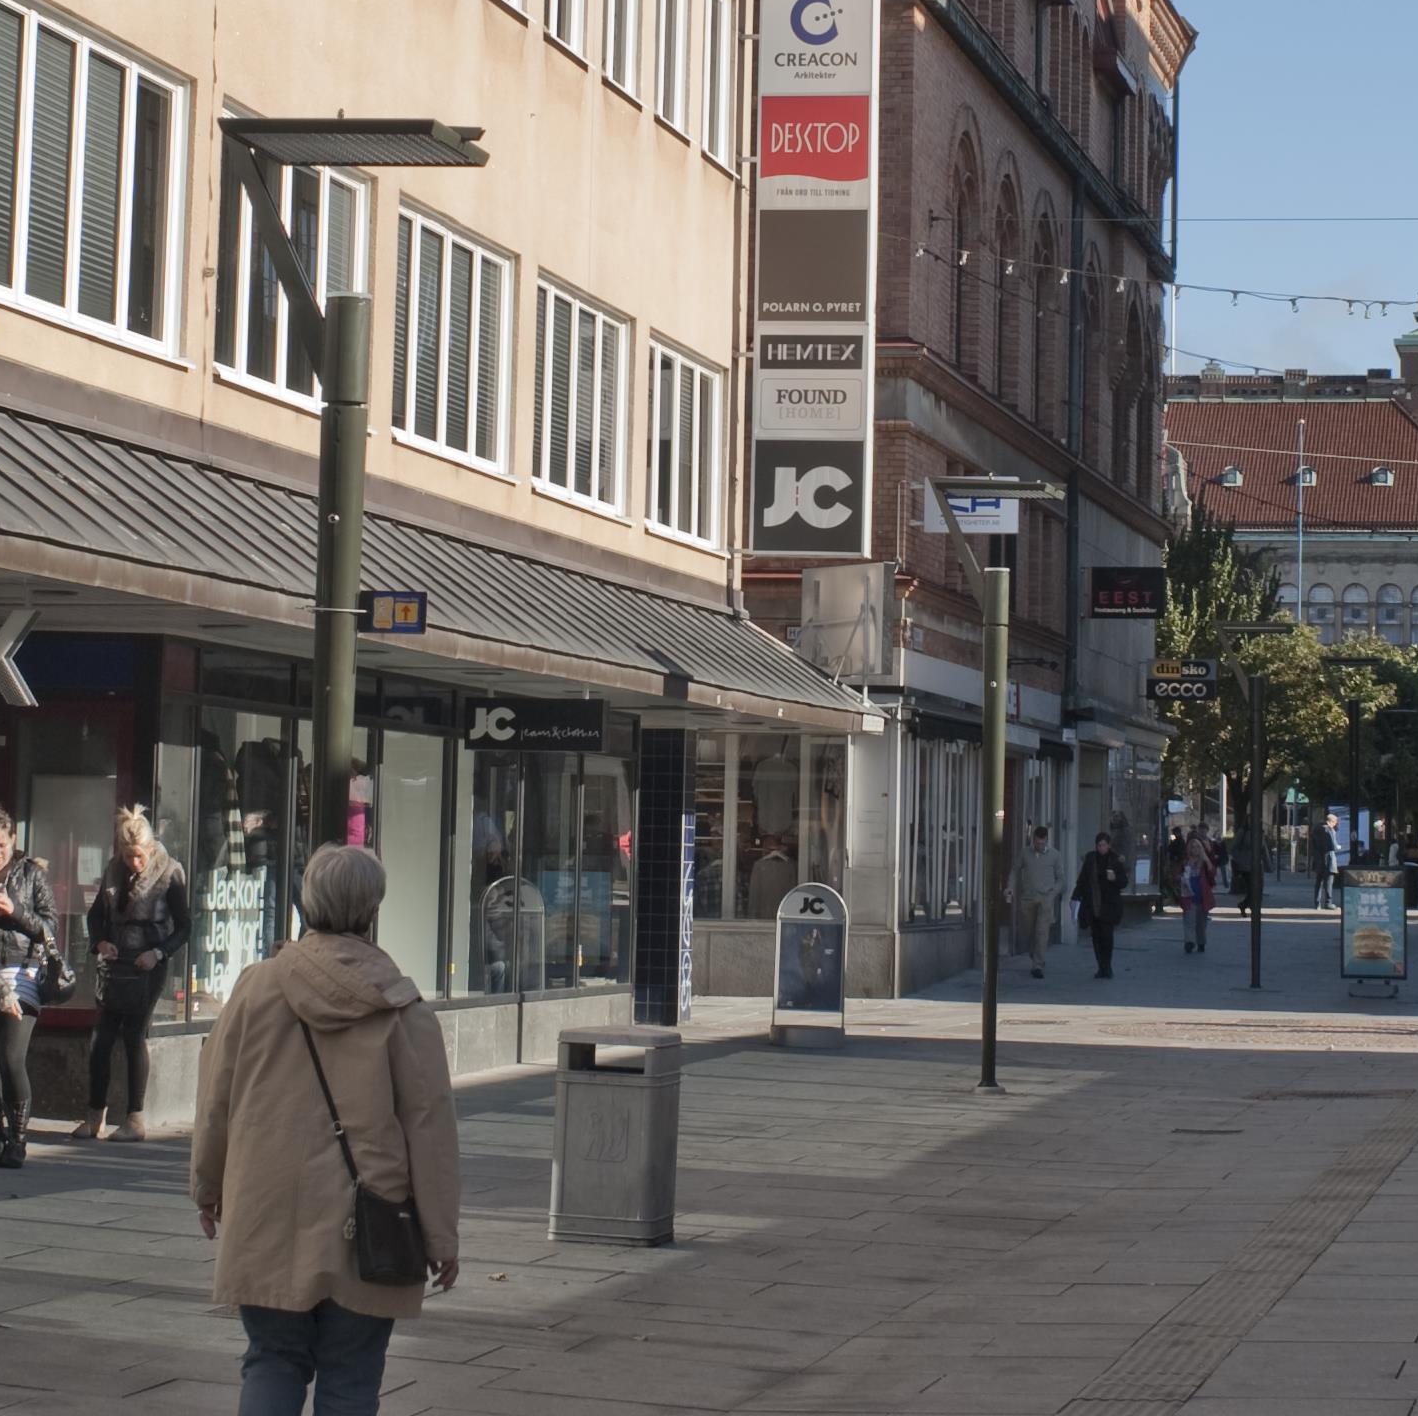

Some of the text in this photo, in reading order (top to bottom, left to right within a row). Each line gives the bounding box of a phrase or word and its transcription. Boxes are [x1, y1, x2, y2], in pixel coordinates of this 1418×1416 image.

[774, 52, 858, 67] CREACON
[793, 71, 837, 80] Arkitekter
[762, 302, 862, 312] POLARN O. PYRET
[767, 343, 856, 360] HEMTEX
[776, 389, 847, 405] FOUND
[763, 465, 853, 529] JC
[1155, 682, 1207, 697] ecco
[469, 707, 517, 741] JC
[207, 867, 265, 910] Jackor!
[799, 897, 825, 915] JC
